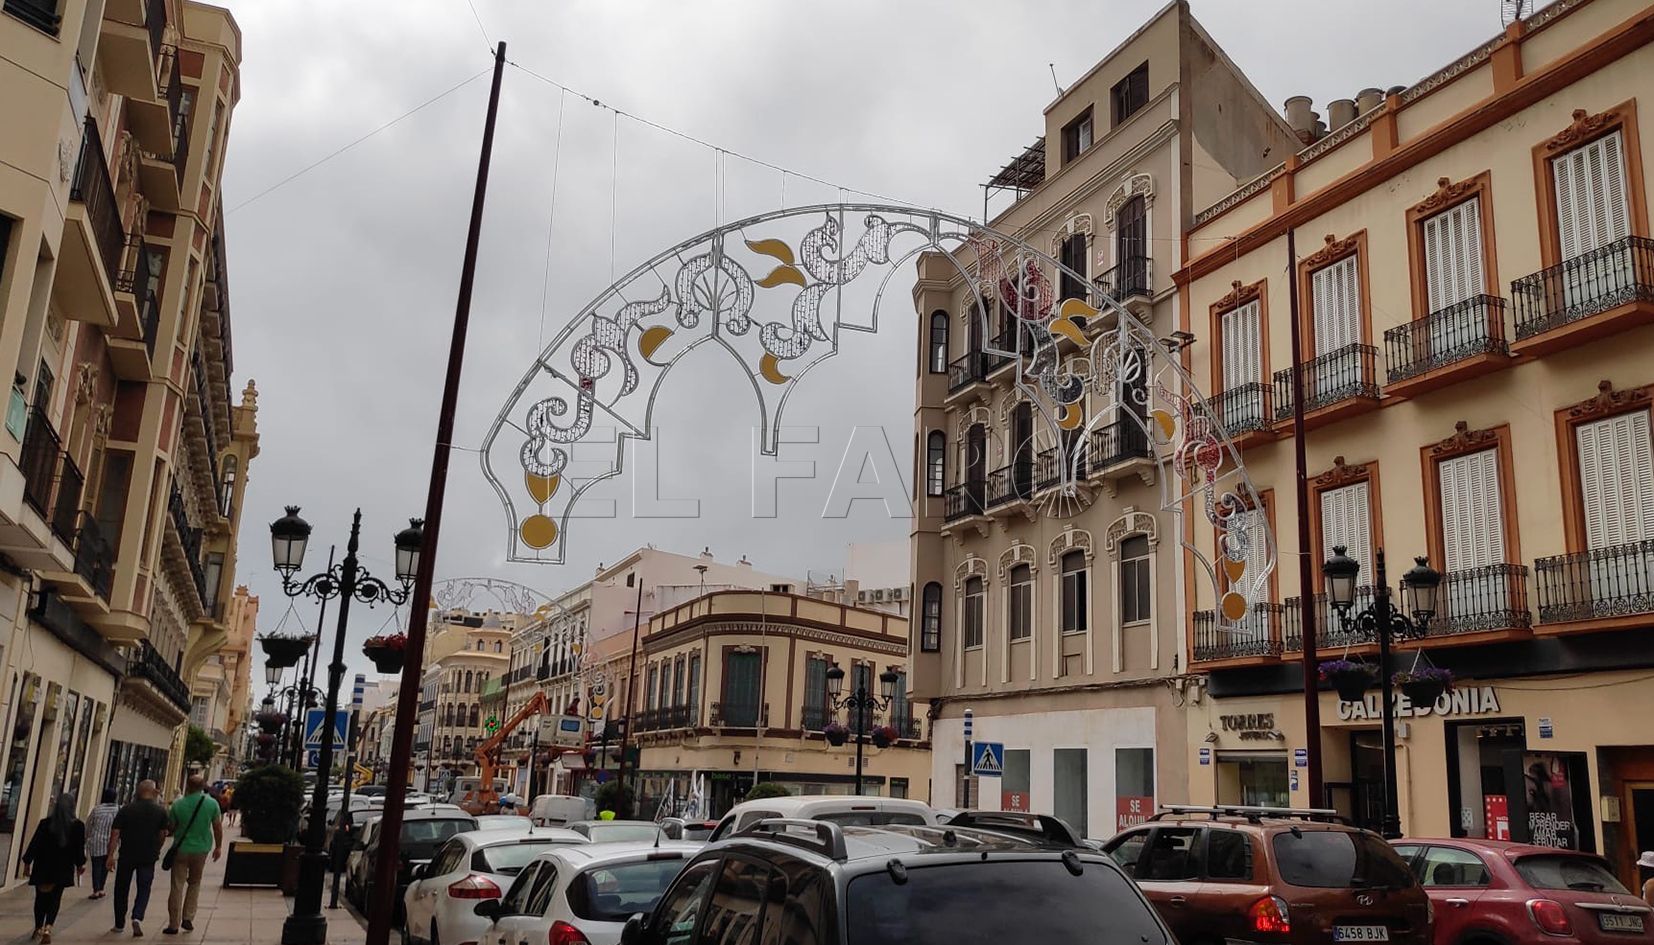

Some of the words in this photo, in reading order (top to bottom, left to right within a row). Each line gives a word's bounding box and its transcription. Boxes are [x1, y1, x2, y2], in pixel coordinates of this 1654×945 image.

[1220, 713, 1275, 731] TORRES
[1011, 795, 1020, 807] SE
[1130, 800, 1140, 812] SE
[1529, 812, 1557, 822] BESAR
[1338, 928, 1363, 939] 6458
[1367, 928, 1386, 939] BJK
